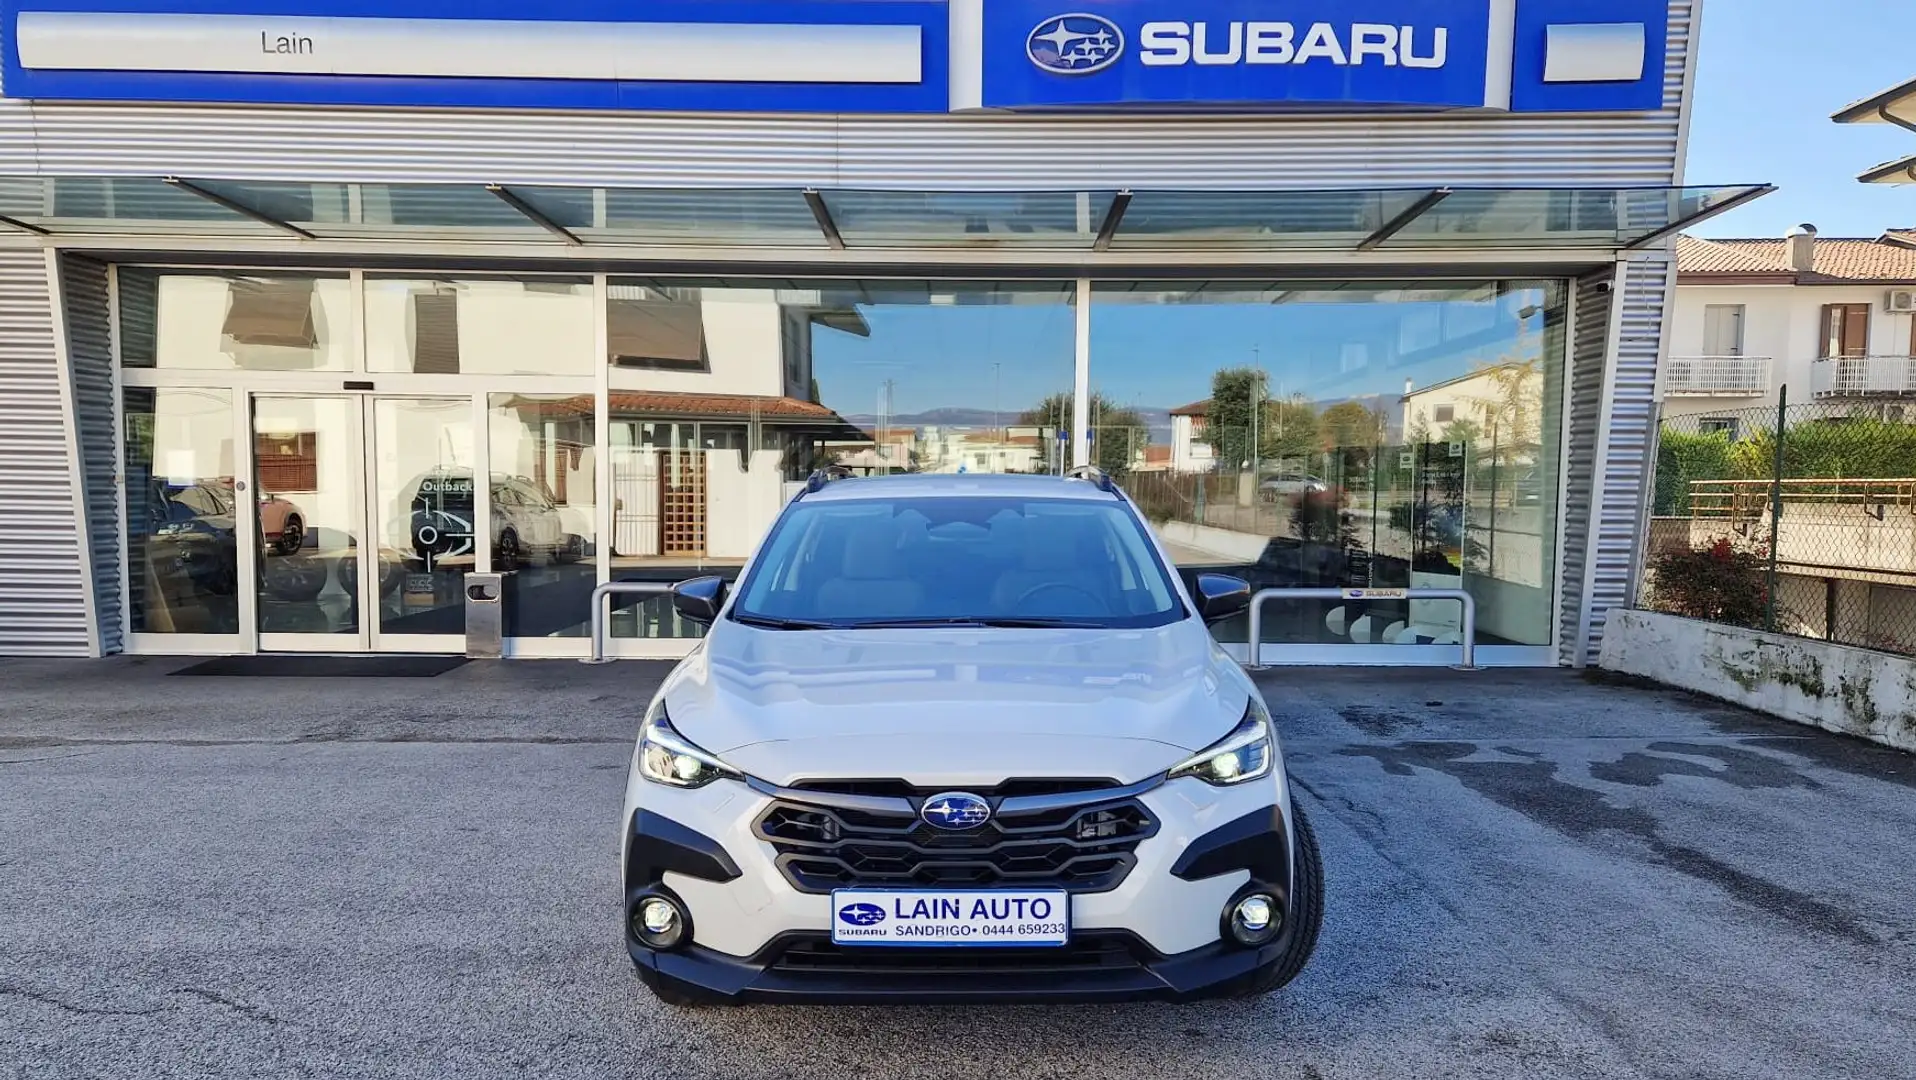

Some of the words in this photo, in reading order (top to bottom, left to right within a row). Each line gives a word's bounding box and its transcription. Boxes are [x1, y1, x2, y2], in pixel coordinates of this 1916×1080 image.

[261, 31, 313, 54] Lain
[1140, 21, 1447, 69] SUBARU
[423, 481, 473, 492] Outback
[895, 898, 960, 920] LAIN
[970, 897, 1052, 920] AUTO
[838, 928, 888, 936] SUBARU
[982, 924, 1014, 936] 0444
[1017, 922, 1066, 935] 659233
